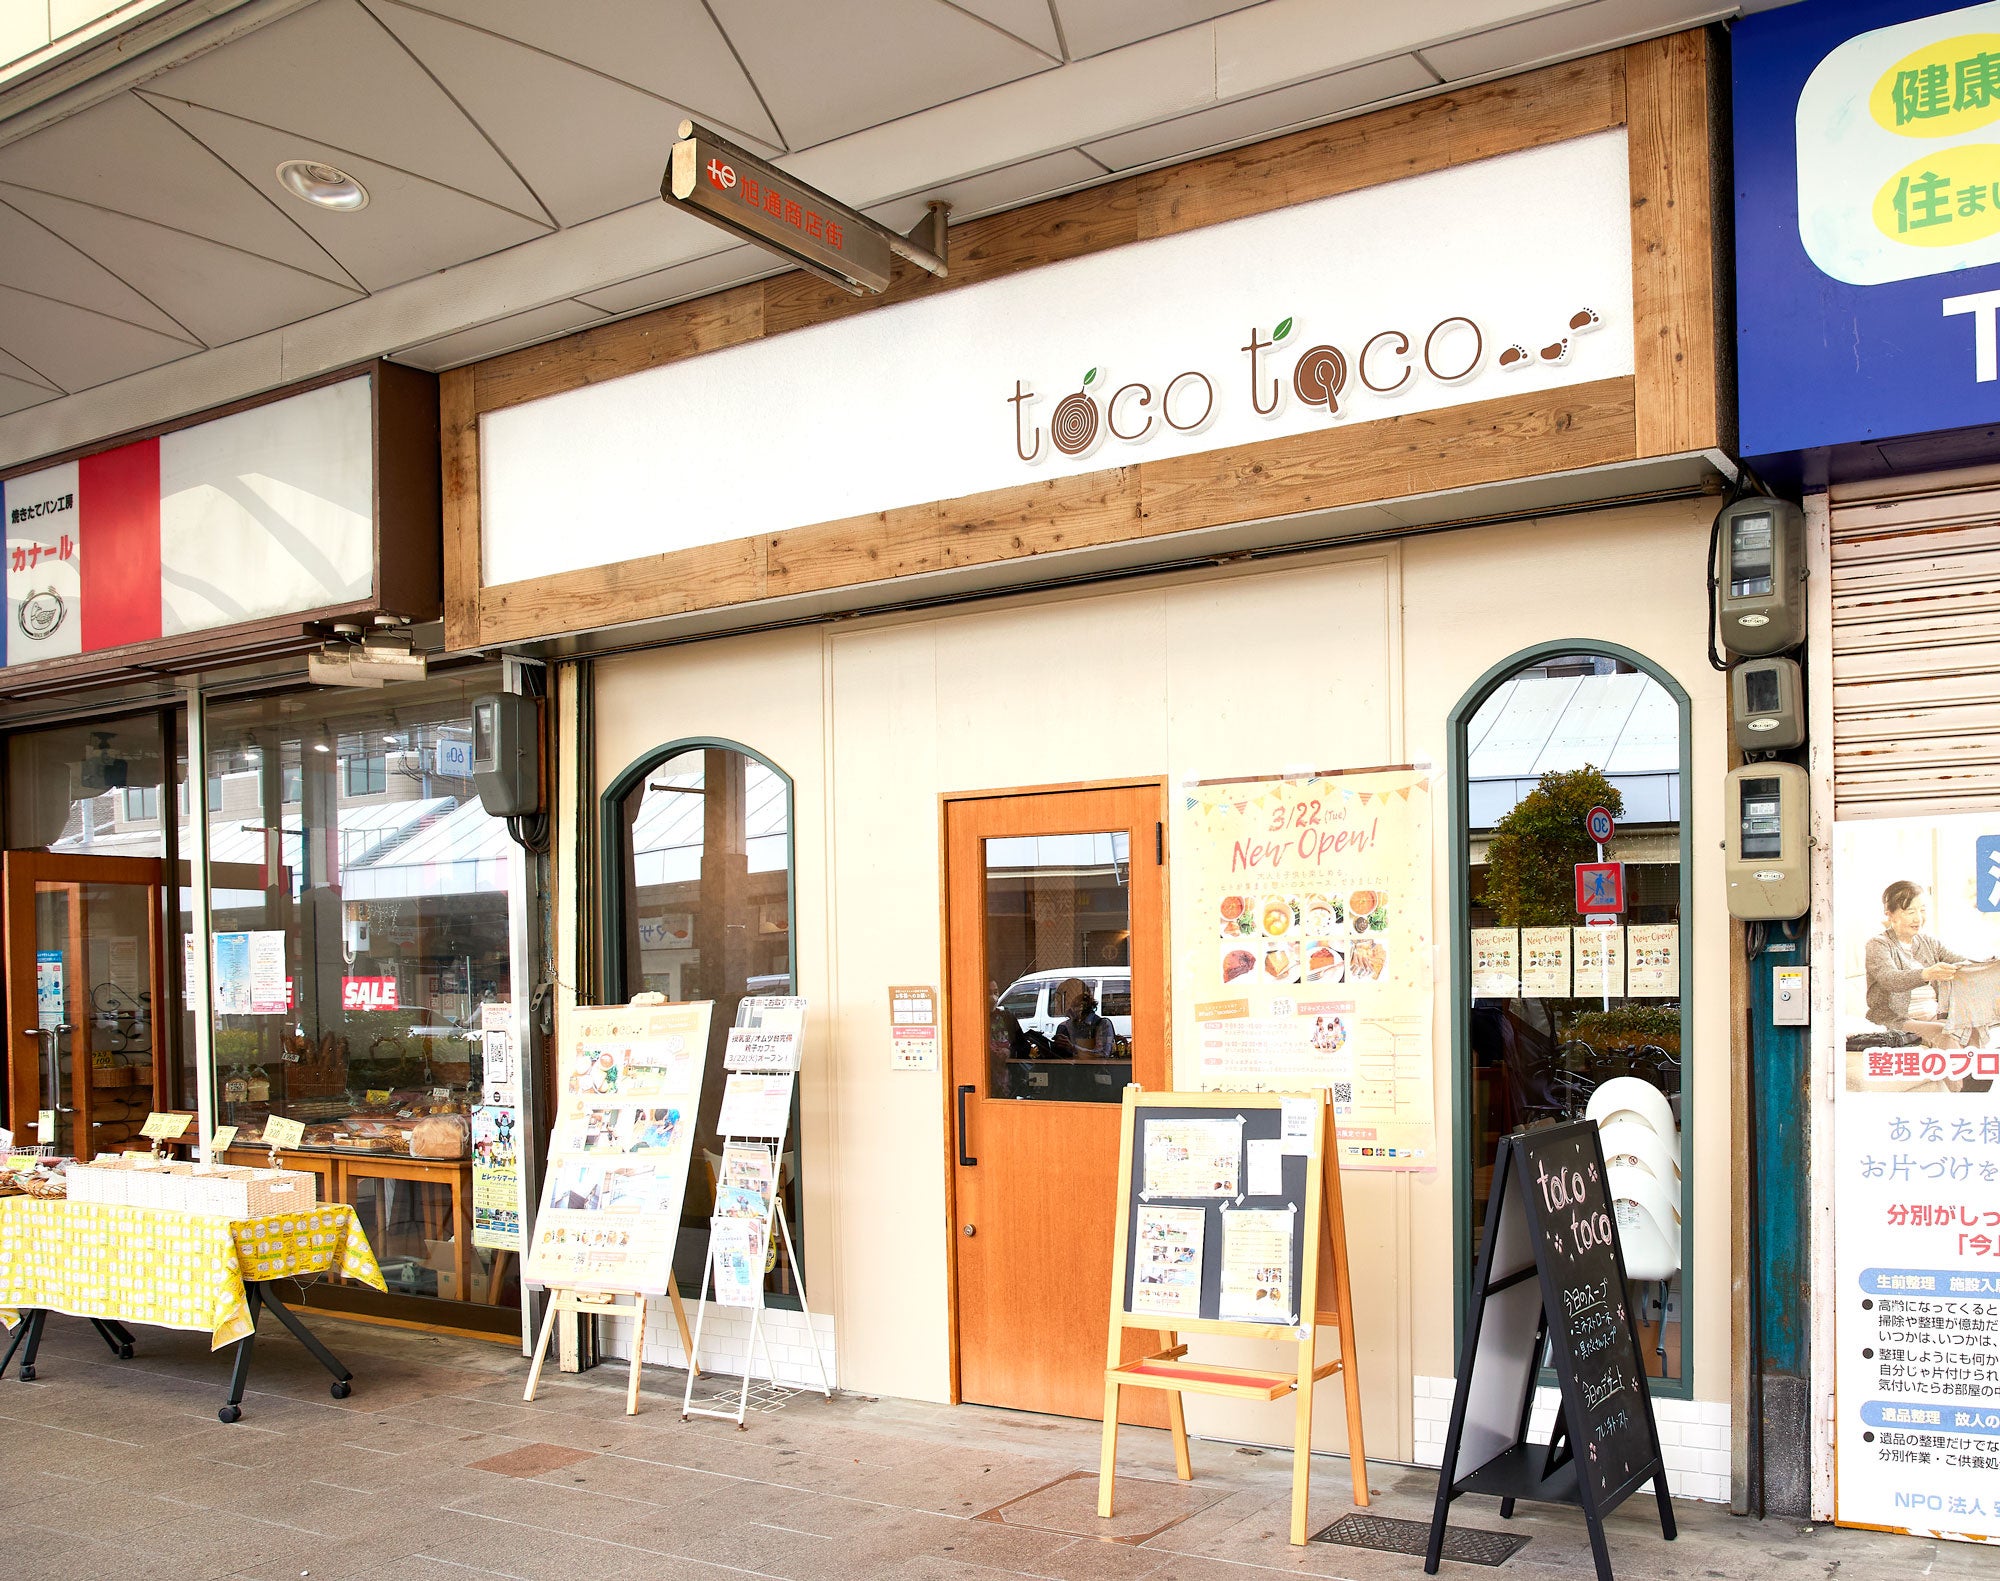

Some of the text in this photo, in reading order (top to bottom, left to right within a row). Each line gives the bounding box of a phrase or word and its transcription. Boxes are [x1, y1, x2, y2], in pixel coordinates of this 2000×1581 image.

[1892, 52, 2000, 126] 健康
[739, 176, 844, 251] 旭通商店街
[1008, 316, 1483, 462] toco toco
[11, 494, 74, 524] 焼きたてパン工房
[12, 535, 74, 573] カナール
[1232, 817, 1378, 872] New Open!
[345, 981, 395, 1006] SALE
[1868, 1051, 2000, 1076] 整理のプロ
[1860, 1154, 1999, 1181] お片づけを
[1536, 1159, 1586, 1214] toco
[1570, 1210, 1612, 1255] toco
[1876, 1274, 1935, 1291] 生前整理
[1563, 1277, 1608, 1316] 今日のスープ
[1878, 1299, 1998, 1316] 高齢になってくると
[1878, 1315, 1999, 1332] 掃除や整理が億劫だ
[1879, 1331, 1997, 1347] いつかは、いつかは、
[1879, 1348, 1999, 1367] 整理しようにも何か
[1880, 1364, 1999, 1381] 自分じゃ片付けられ
[1881, 1407, 2000, 1429] 遺品整理 故人の
[1879, 1432, 1999, 1452] 遺品の整理だけでな
[1895, 1492, 1942, 1511] NPO
[1948, 1496, 1986, 1517] 法人
